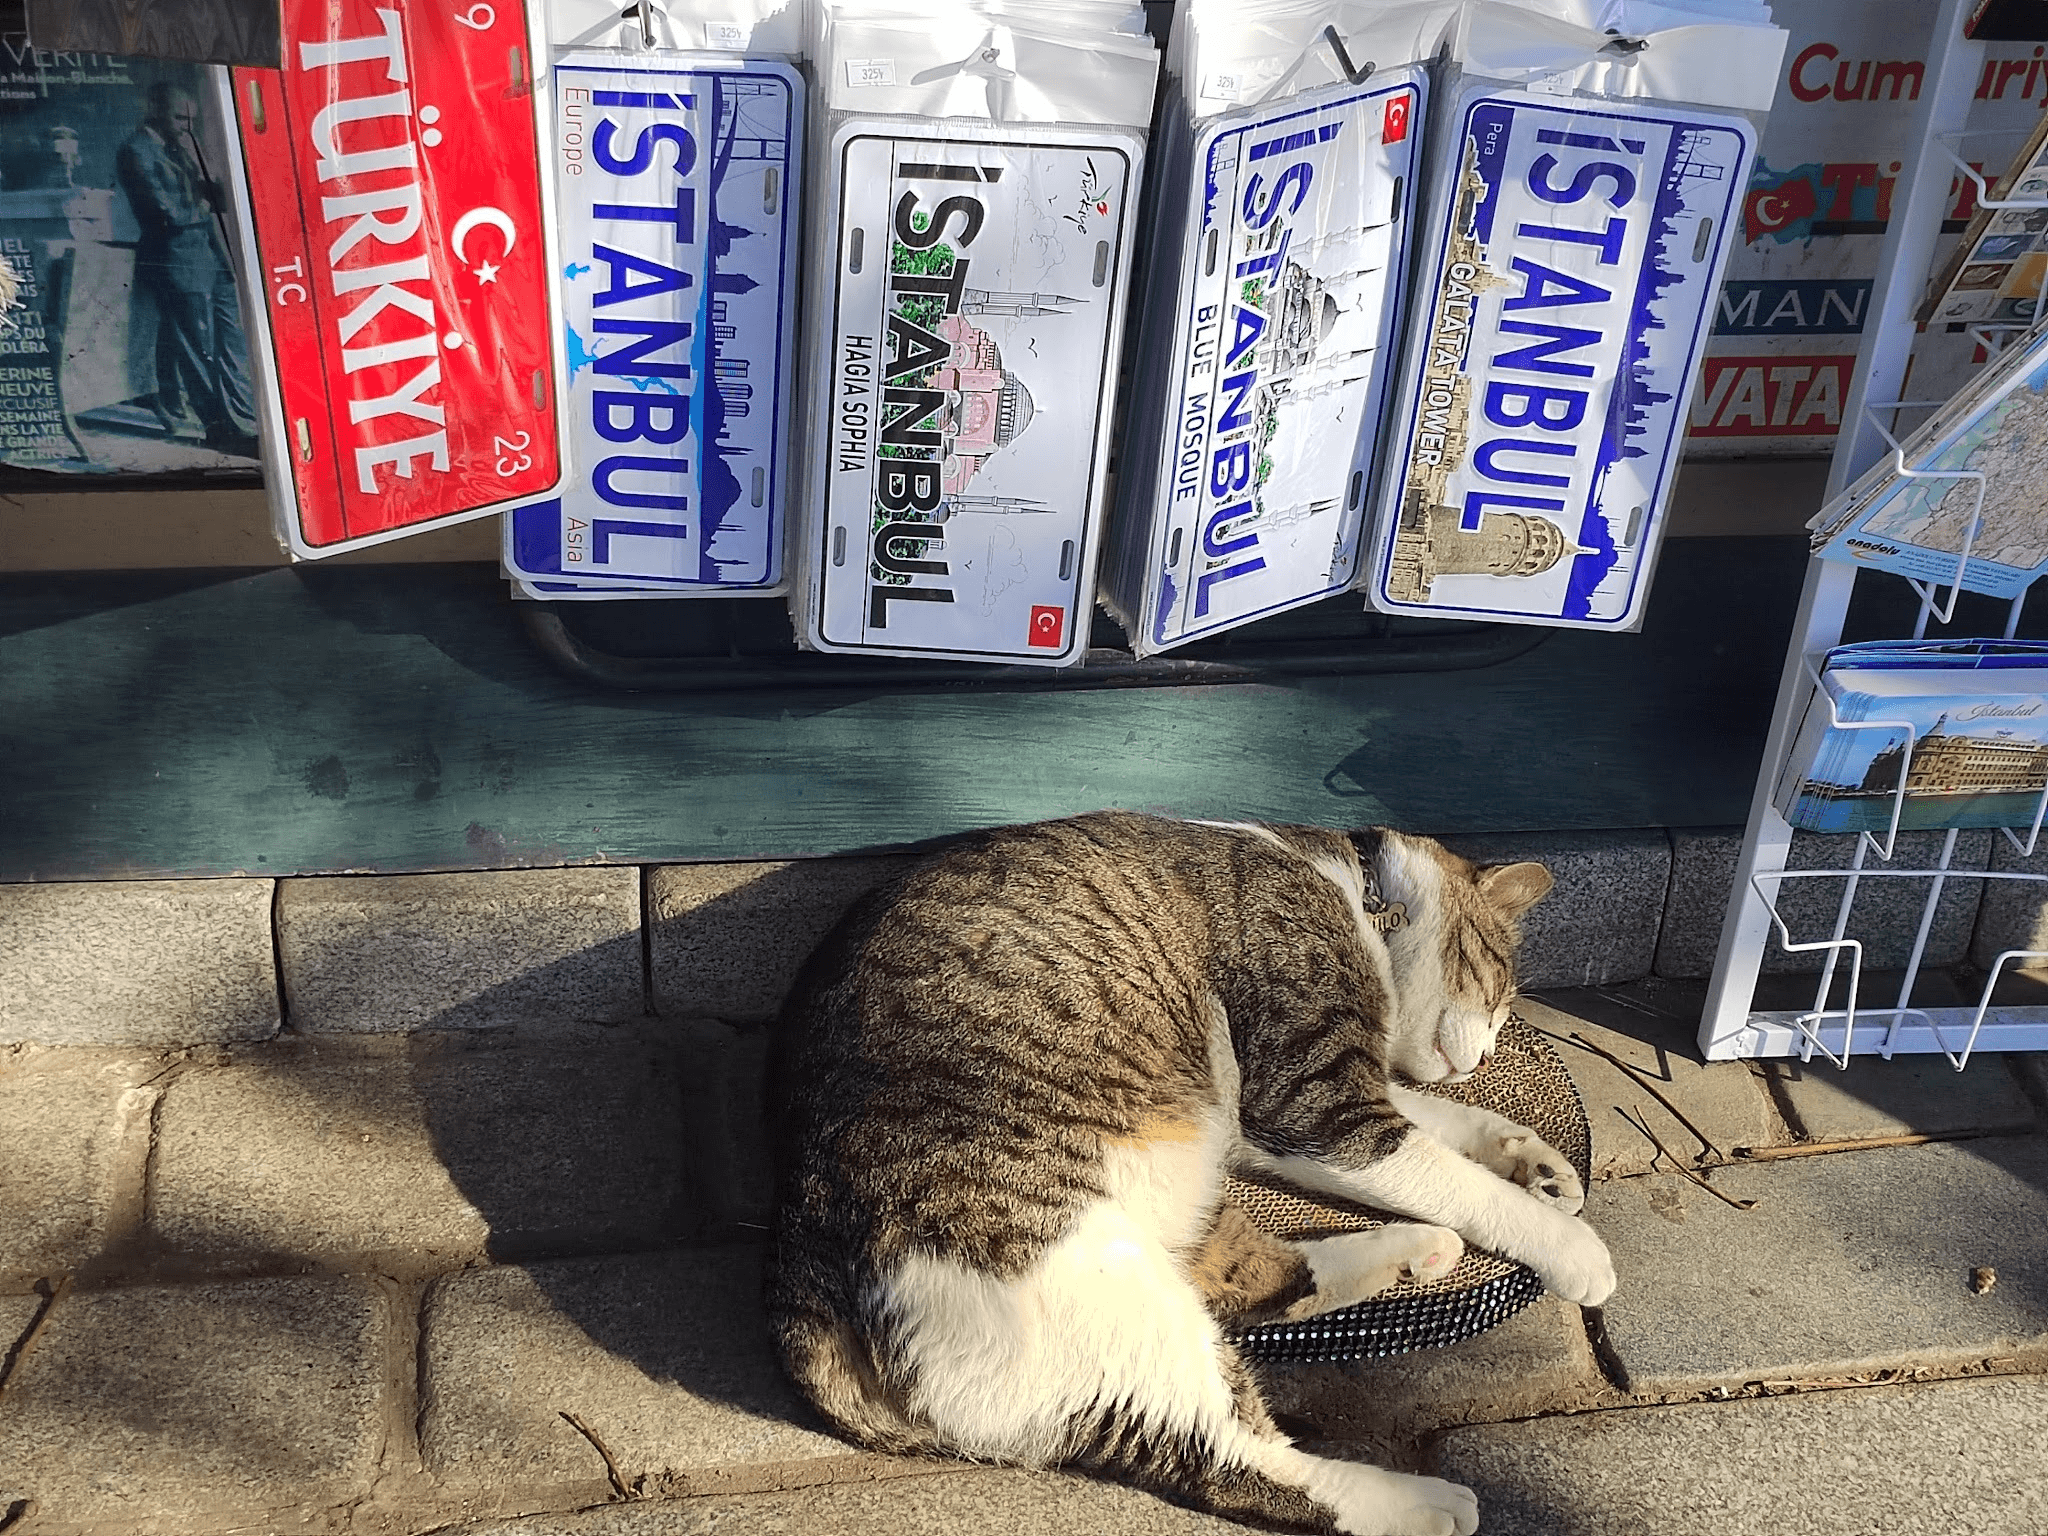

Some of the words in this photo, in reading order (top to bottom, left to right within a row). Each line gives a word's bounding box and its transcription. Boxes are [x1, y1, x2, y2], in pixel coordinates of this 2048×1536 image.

[565, 87, 590, 176] Europe
[1484, 122, 1503, 157] Pera
[298, 8, 464, 495] TÜRKİYE
[453, 2, 496, 31] 9
[494, 430, 532, 477] 23
[273, 256, 307, 306] T.C
[1434, 262, 1476, 368] GALATA
[24, 327, 46, 340] DU
[843, 335, 873, 396] HAGIA
[1190, 304, 1219, 378] BLUE
[839, 401, 869, 472] SOPHIA
[1176, 391, 1209, 502] MOSQUE
[1416, 375, 1456, 466] TOWER
[567, 516, 589, 562] Asia
